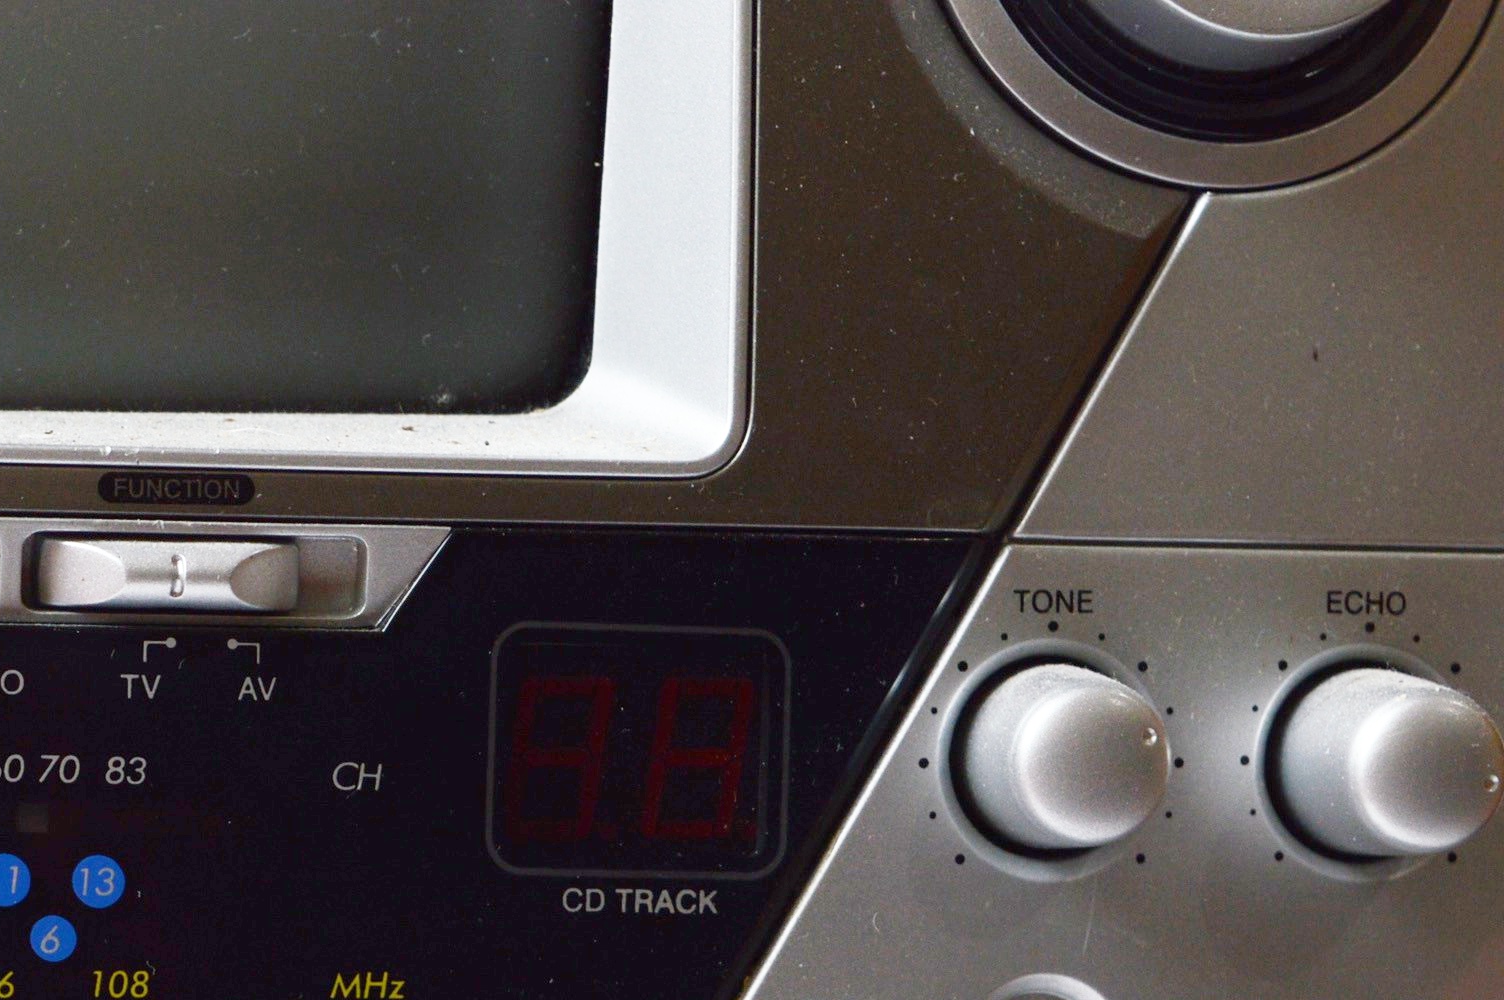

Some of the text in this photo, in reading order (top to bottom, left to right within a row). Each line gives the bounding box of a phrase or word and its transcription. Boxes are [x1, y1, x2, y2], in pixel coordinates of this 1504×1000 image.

[115, 478, 240, 499] FUNCTION
[1014, 590, 1092, 613] TONE
[1327, 591, 1406, 616] ECHO
[121, 674, 160, 699] TV
[238, 677, 276, 700] AV
[39, 755, 80, 783] 70
[106, 757, 146, 784] 83
[333, 762, 382, 790] CH
[81, 868, 115, 896] 13
[563, 888, 717, 914] CD TRACK
[41, 926, 59, 953] 6
[94, 971, 148, 998] 108
[330, 972, 404, 998] MHz
